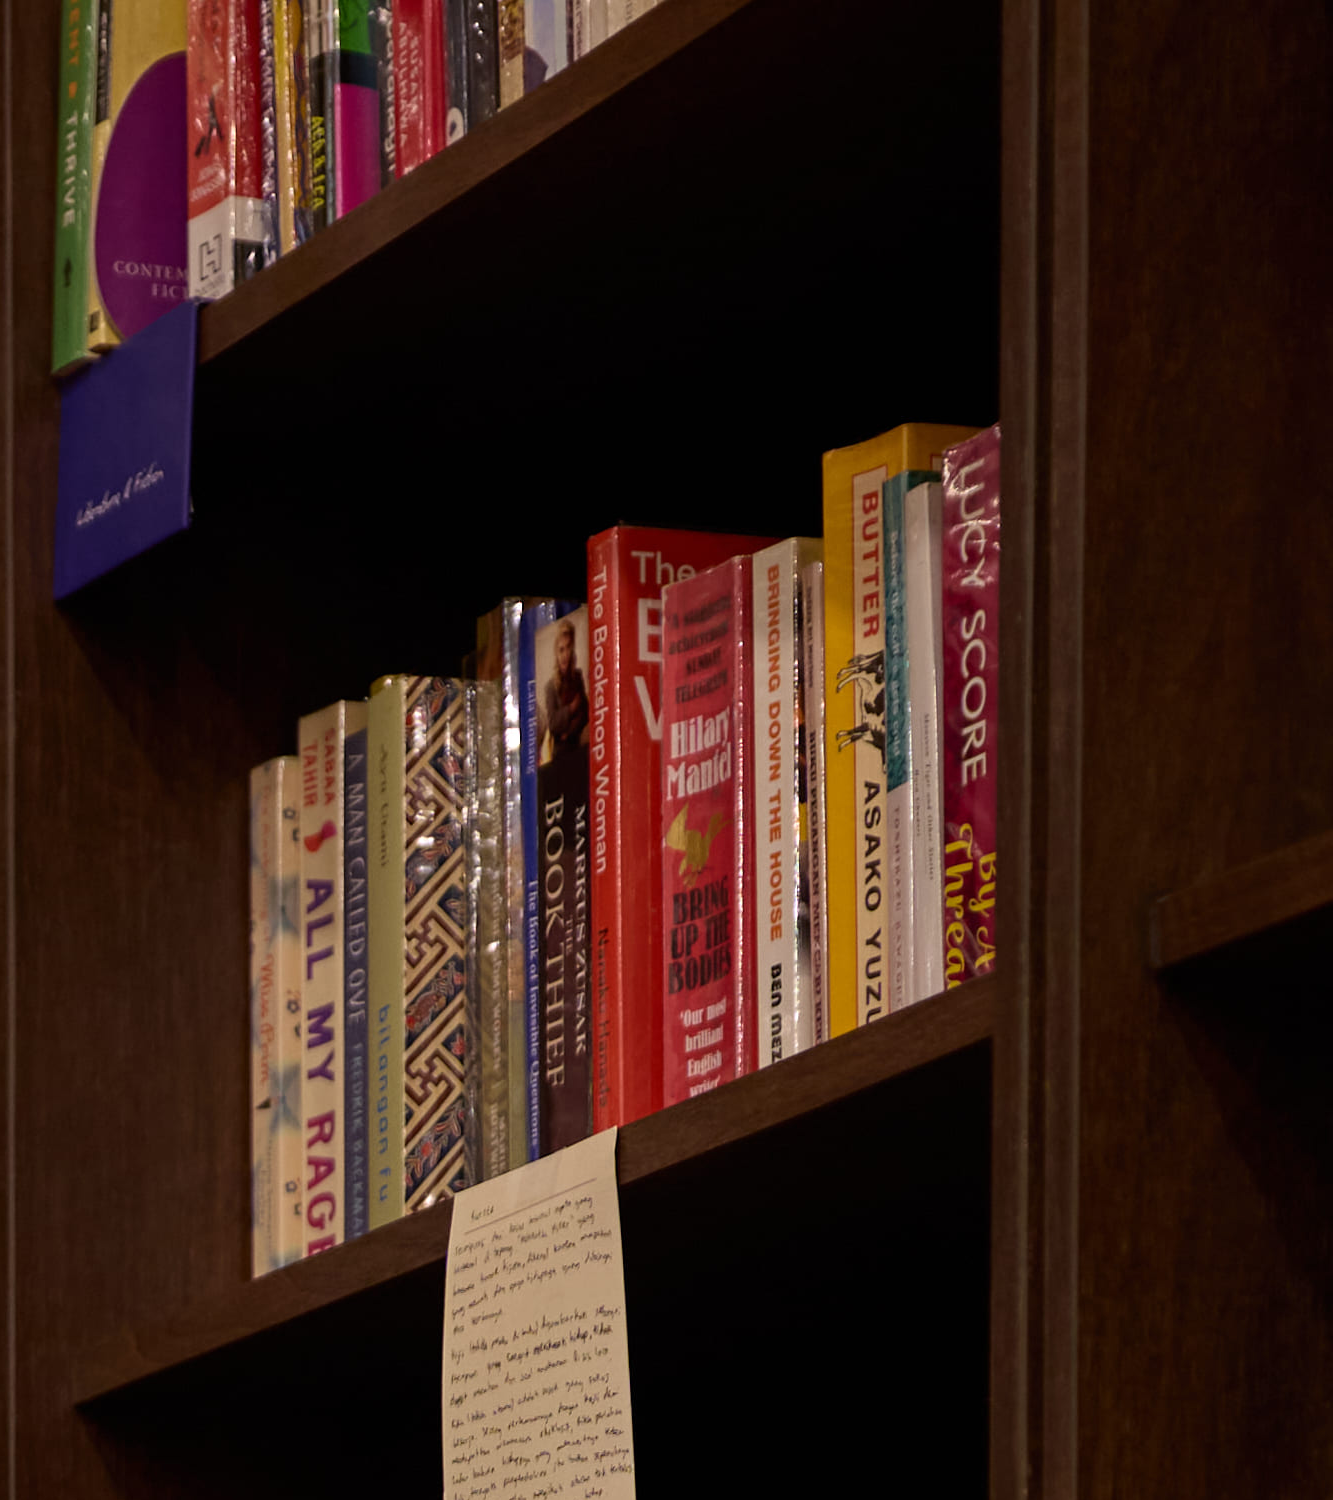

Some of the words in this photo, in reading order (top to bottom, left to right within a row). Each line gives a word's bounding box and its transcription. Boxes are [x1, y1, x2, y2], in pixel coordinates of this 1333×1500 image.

[592, 566, 609, 619] The
[862, 490, 882, 638] BUTTER
[588, 626, 610, 760] Bookshop
[960, 614, 988, 786] SCORE
[541, 796, 566, 934] BOOK
[593, 764, 611, 873] Woman
[863, 779, 884, 912] ASAKO
[305, 878, 335, 979] ALL
[307, 1001, 335, 1082] MY
[545, 945, 567, 1087] THIEF
